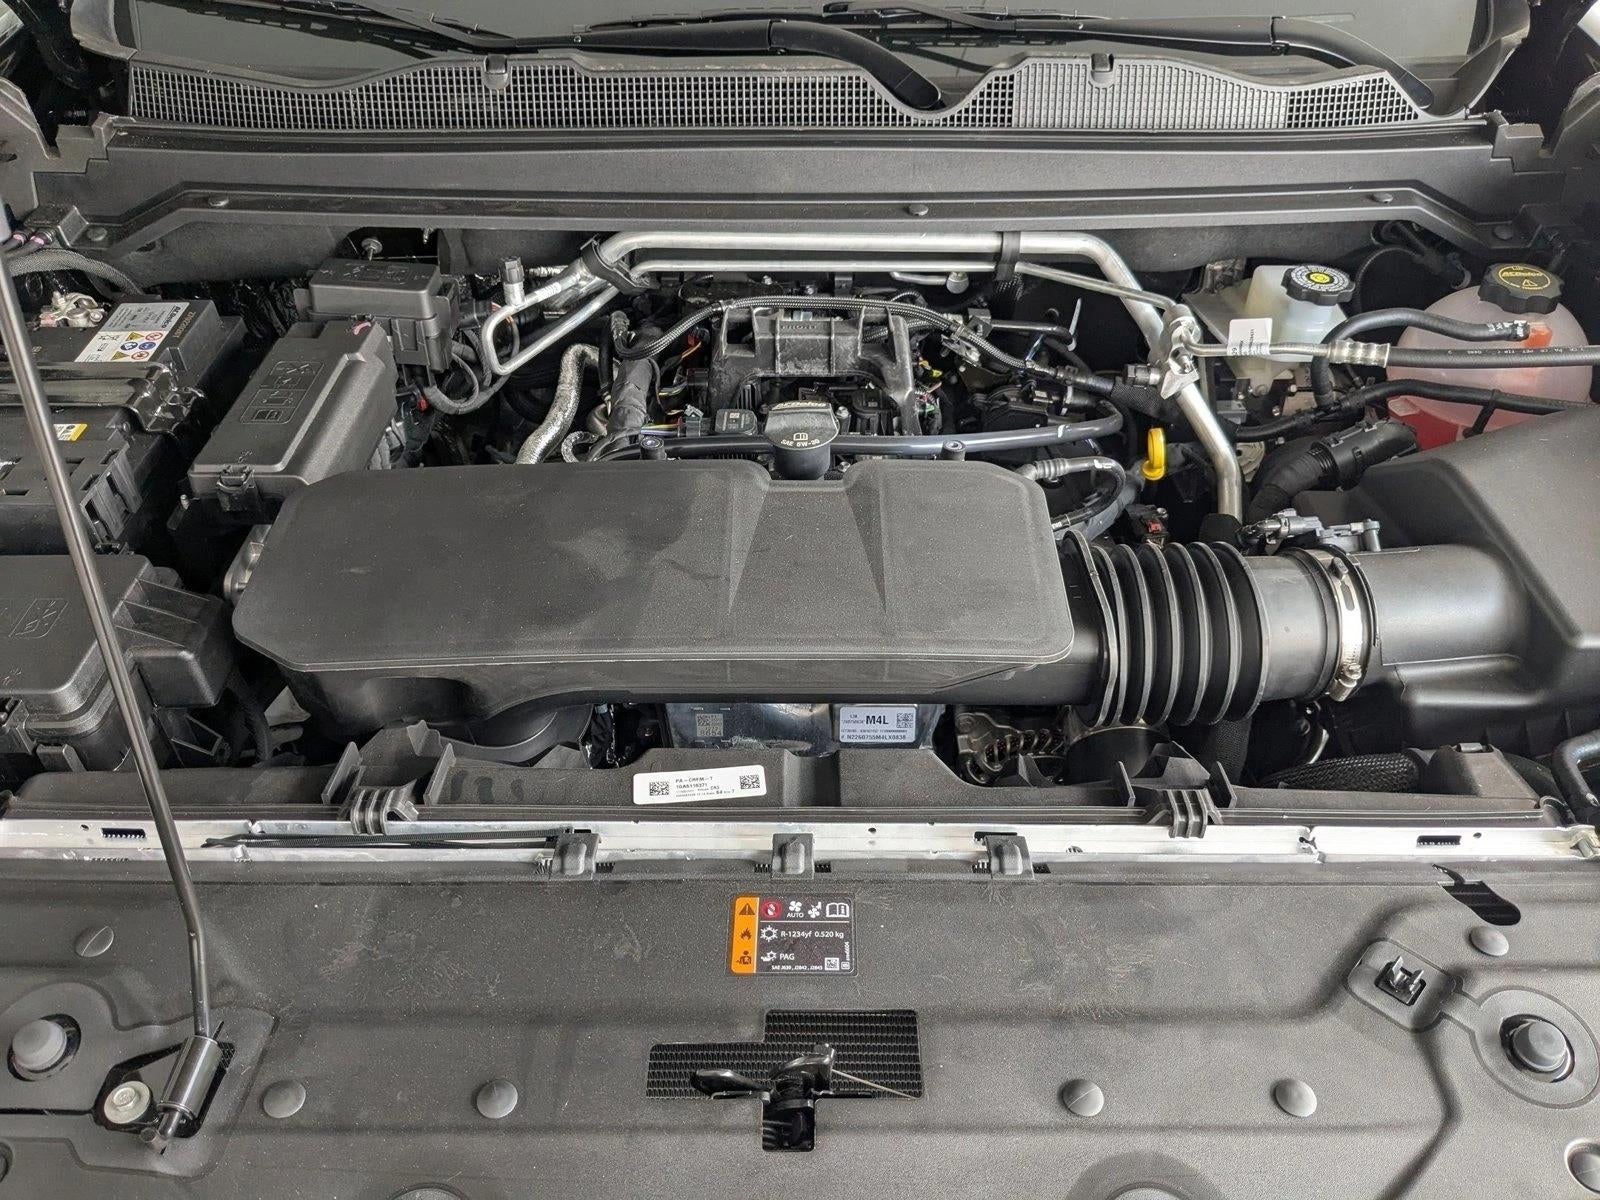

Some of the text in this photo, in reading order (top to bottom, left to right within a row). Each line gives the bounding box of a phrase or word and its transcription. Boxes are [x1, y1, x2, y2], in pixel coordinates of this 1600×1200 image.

[866, 715, 889, 725] M4L
[781, 931, 812, 939] R-1234yf
[835, 931, 844, 939] kg
